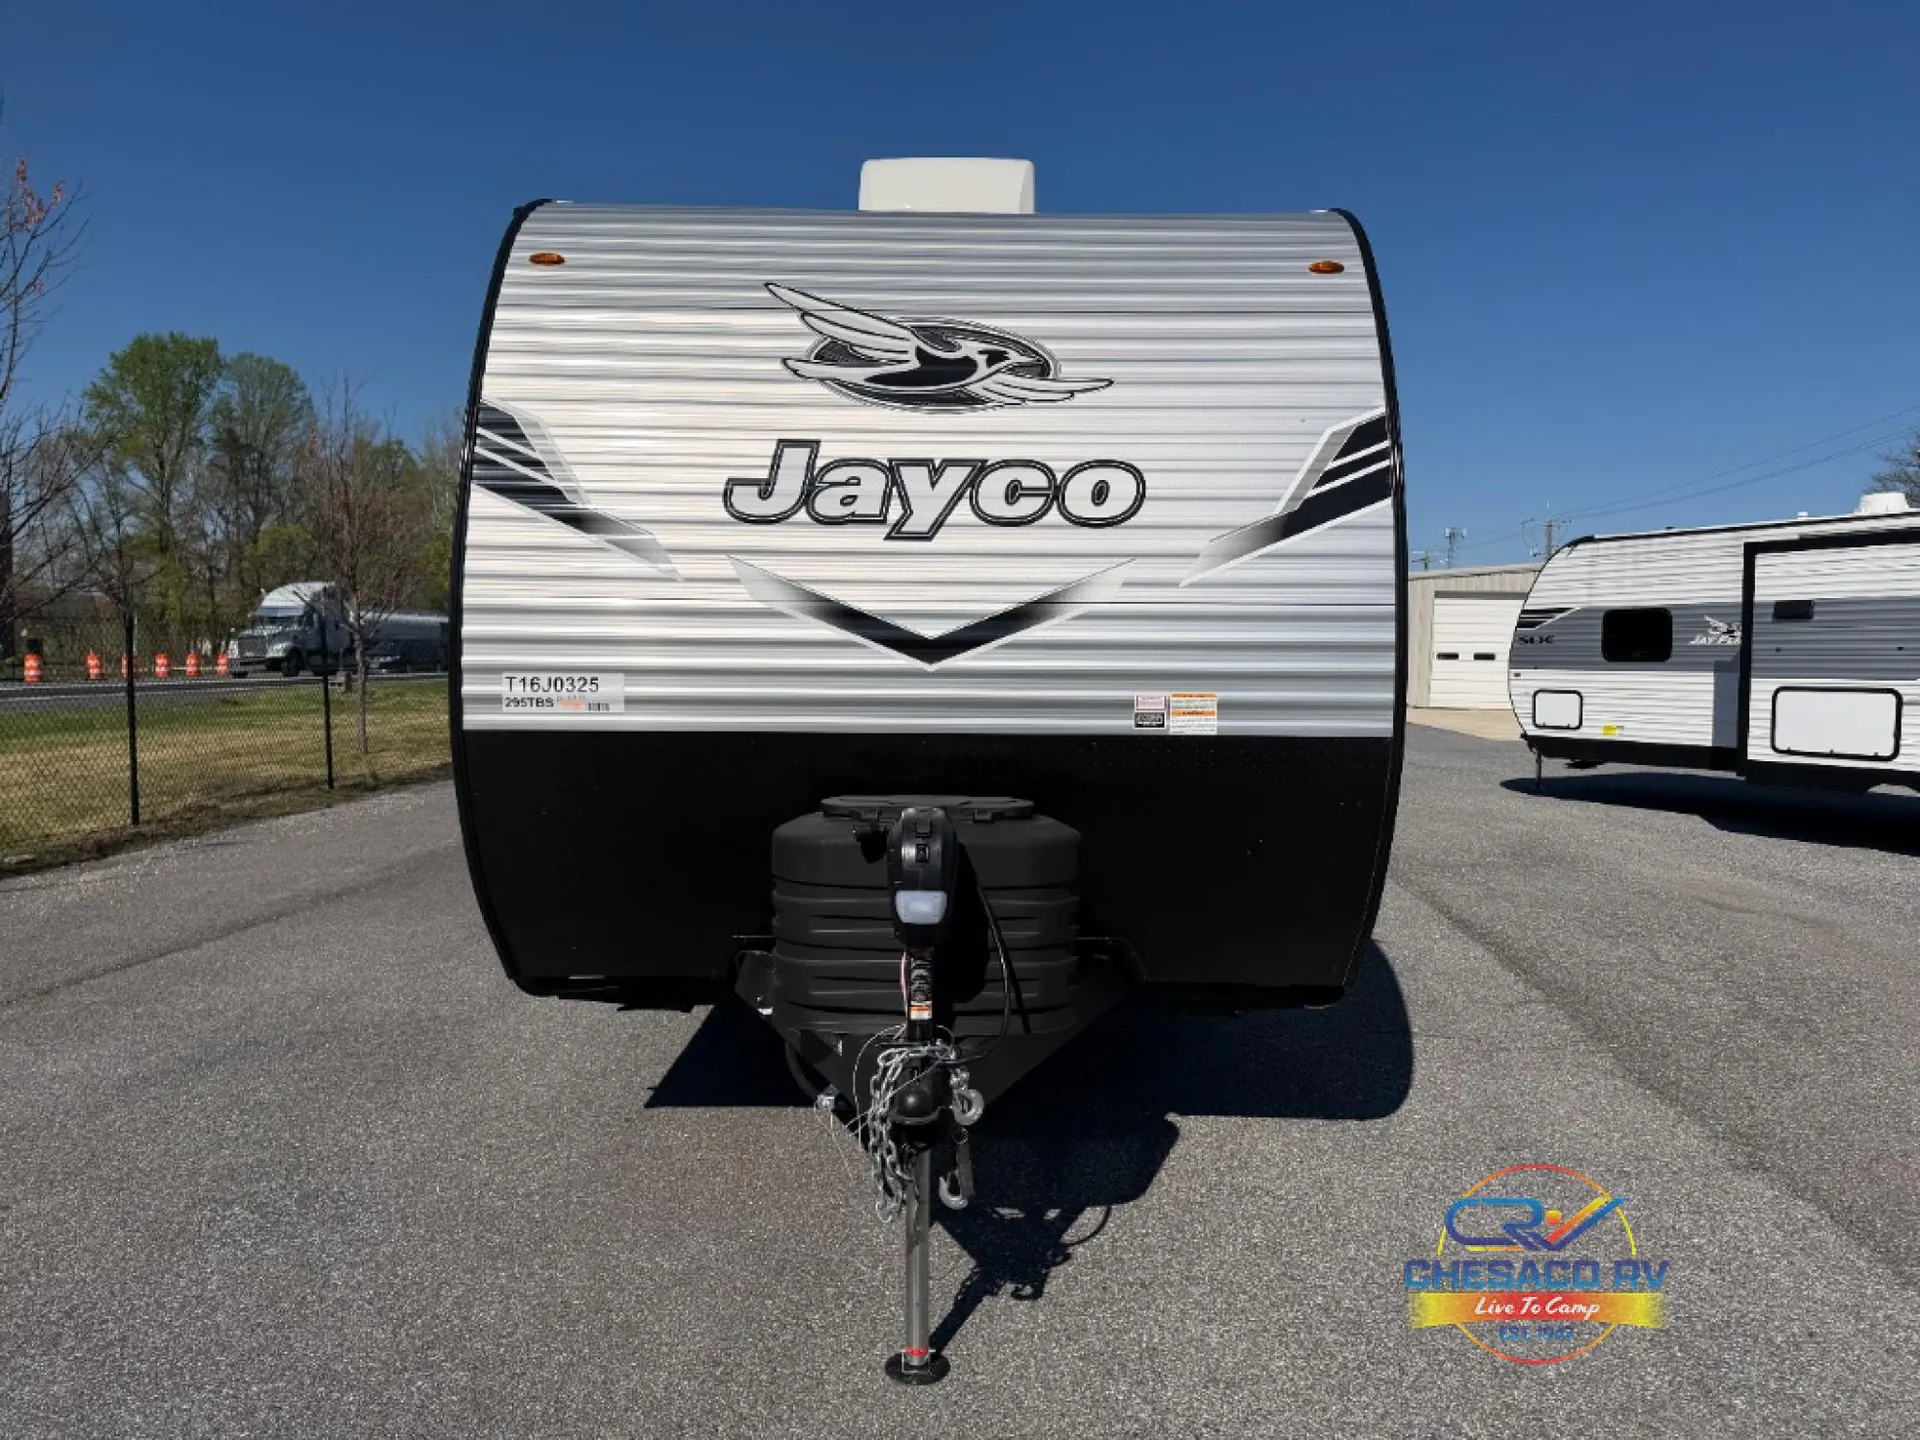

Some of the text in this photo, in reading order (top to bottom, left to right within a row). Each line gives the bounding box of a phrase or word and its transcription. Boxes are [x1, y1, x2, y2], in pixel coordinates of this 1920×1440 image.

[723, 438, 1147, 541] Jayco
[504, 676, 600, 693] T16J0325
[505, 697, 554, 708] 295TBS
